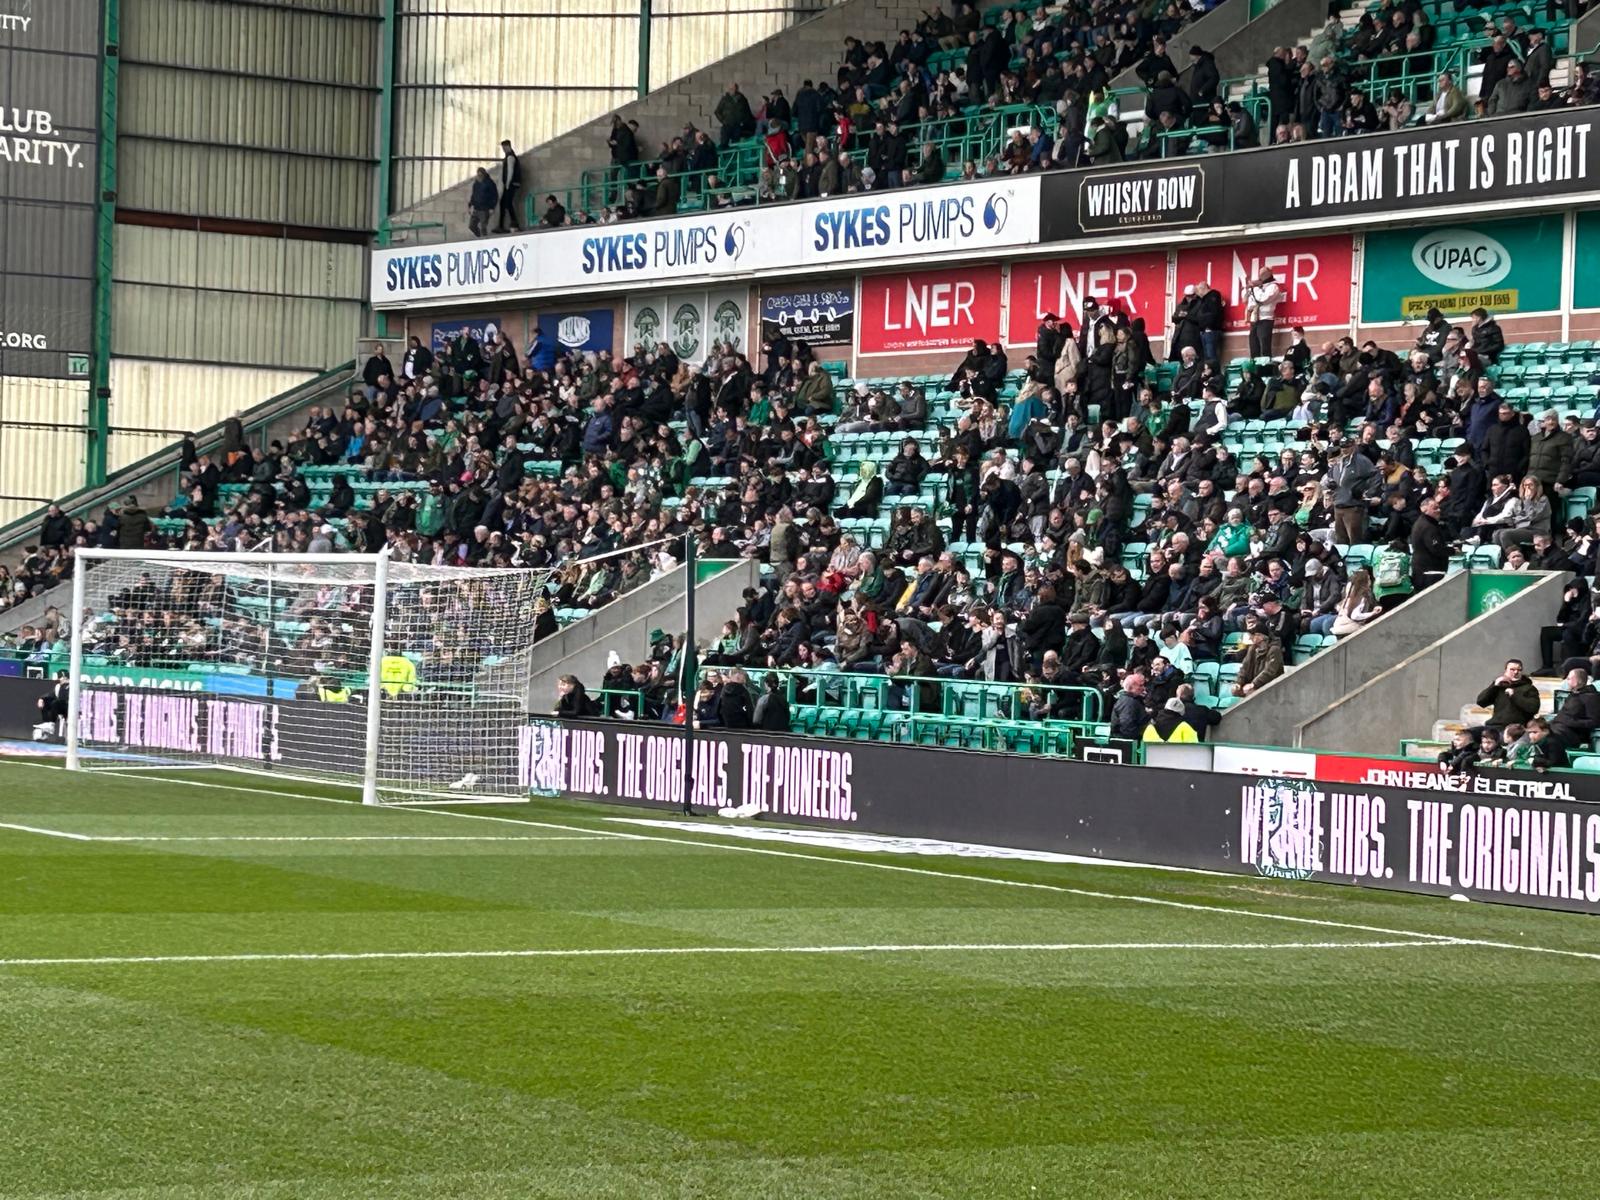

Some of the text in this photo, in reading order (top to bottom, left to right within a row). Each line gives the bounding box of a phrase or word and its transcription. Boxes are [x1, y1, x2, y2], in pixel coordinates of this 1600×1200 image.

[0, 13, 31, 32] ITY
[0, 106, 59, 136] LUB.
[1286, 124, 1592, 208] A DRAM THAT IS RIGHT
[1087, 175, 1196, 217] WHISKY ROW
[814, 196, 975, 251] SYKES PUMPS
[386, 247, 501, 291] SYKES PUMPS
[582, 225, 718, 274] SYKES PUMPS
[1434, 246, 1488, 270] UPAC
[1206, 251, 1319, 308] NER
[884, 277, 975, 336] LNER
[570, 729, 609, 795] HIBS.
[616, 733, 644, 799] THE
[741, 743, 769, 812] THE
[773, 745, 857, 822] PIONEERS.
[1361, 768, 1403, 787] JOHN
[1474, 775, 1576, 800] ELECTRICAL
[1329, 793, 1394, 879] HIBS.
[1407, 800, 1453, 886] THE
[1459, 804, 1600, 903] ORIGINALS
